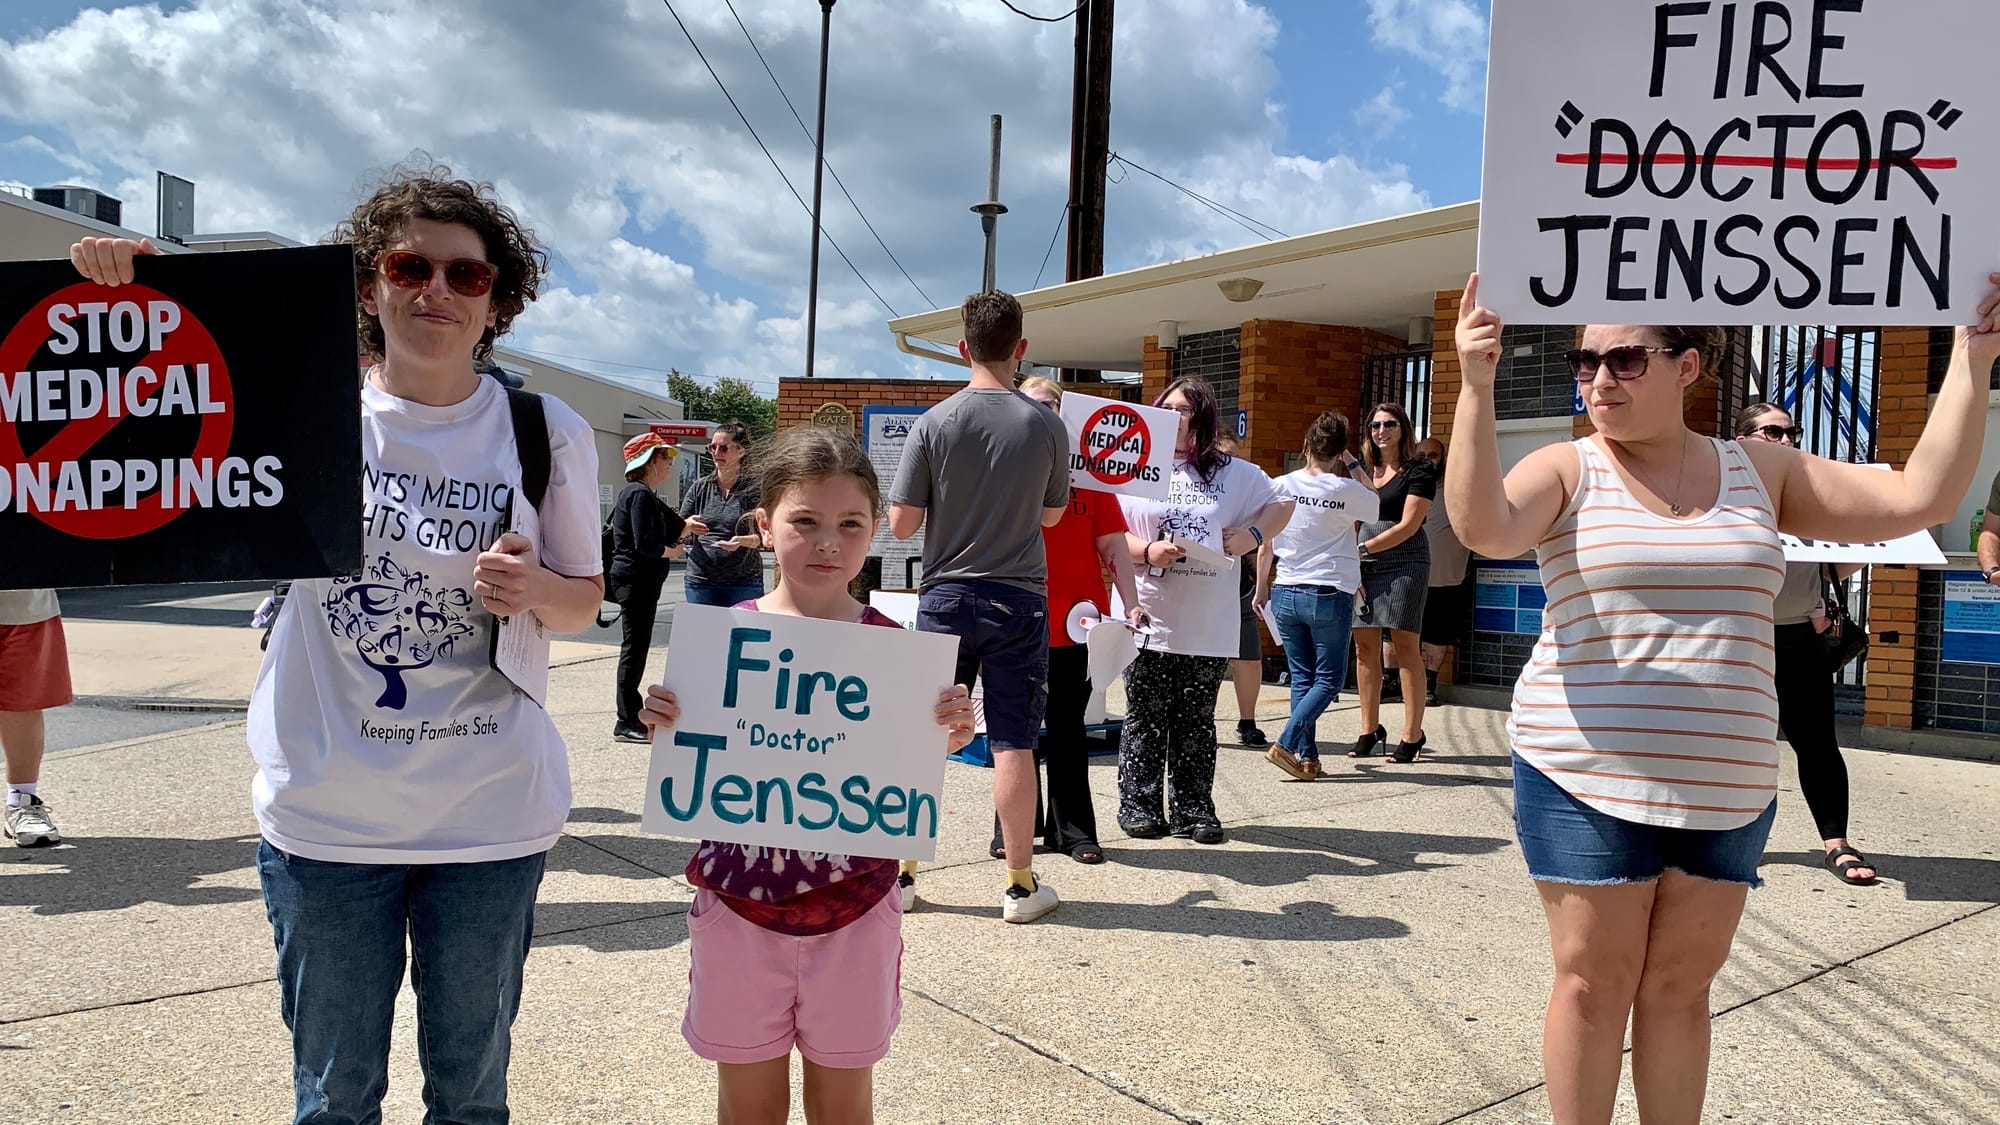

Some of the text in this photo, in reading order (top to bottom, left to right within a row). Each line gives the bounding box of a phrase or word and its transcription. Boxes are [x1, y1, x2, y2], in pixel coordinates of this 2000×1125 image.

[1649, 0, 1865, 103] FIRE
[1529, 213, 1951, 310] JENSSEN
[47, 300, 182, 355] STOP
[0, 363, 226, 423] MEDICAL
[819, 415, 847, 424] GATE
[1100, 410, 1138, 428] STOP
[1238, 412, 1246, 437] 6
[1084, 430, 1148, 456] MEDICAL
[1184, 494, 1218, 505] GROUP
[1186, 482, 1226, 494] MEDICAL
[1170, 567, 1188, 576] Keeping
[1190, 568, 1208, 576] Families
[722, 628, 870, 722] Fire
[360, 714, 498, 744] Keeping Families Safe
[660, 731, 938, 838] Jenssen
